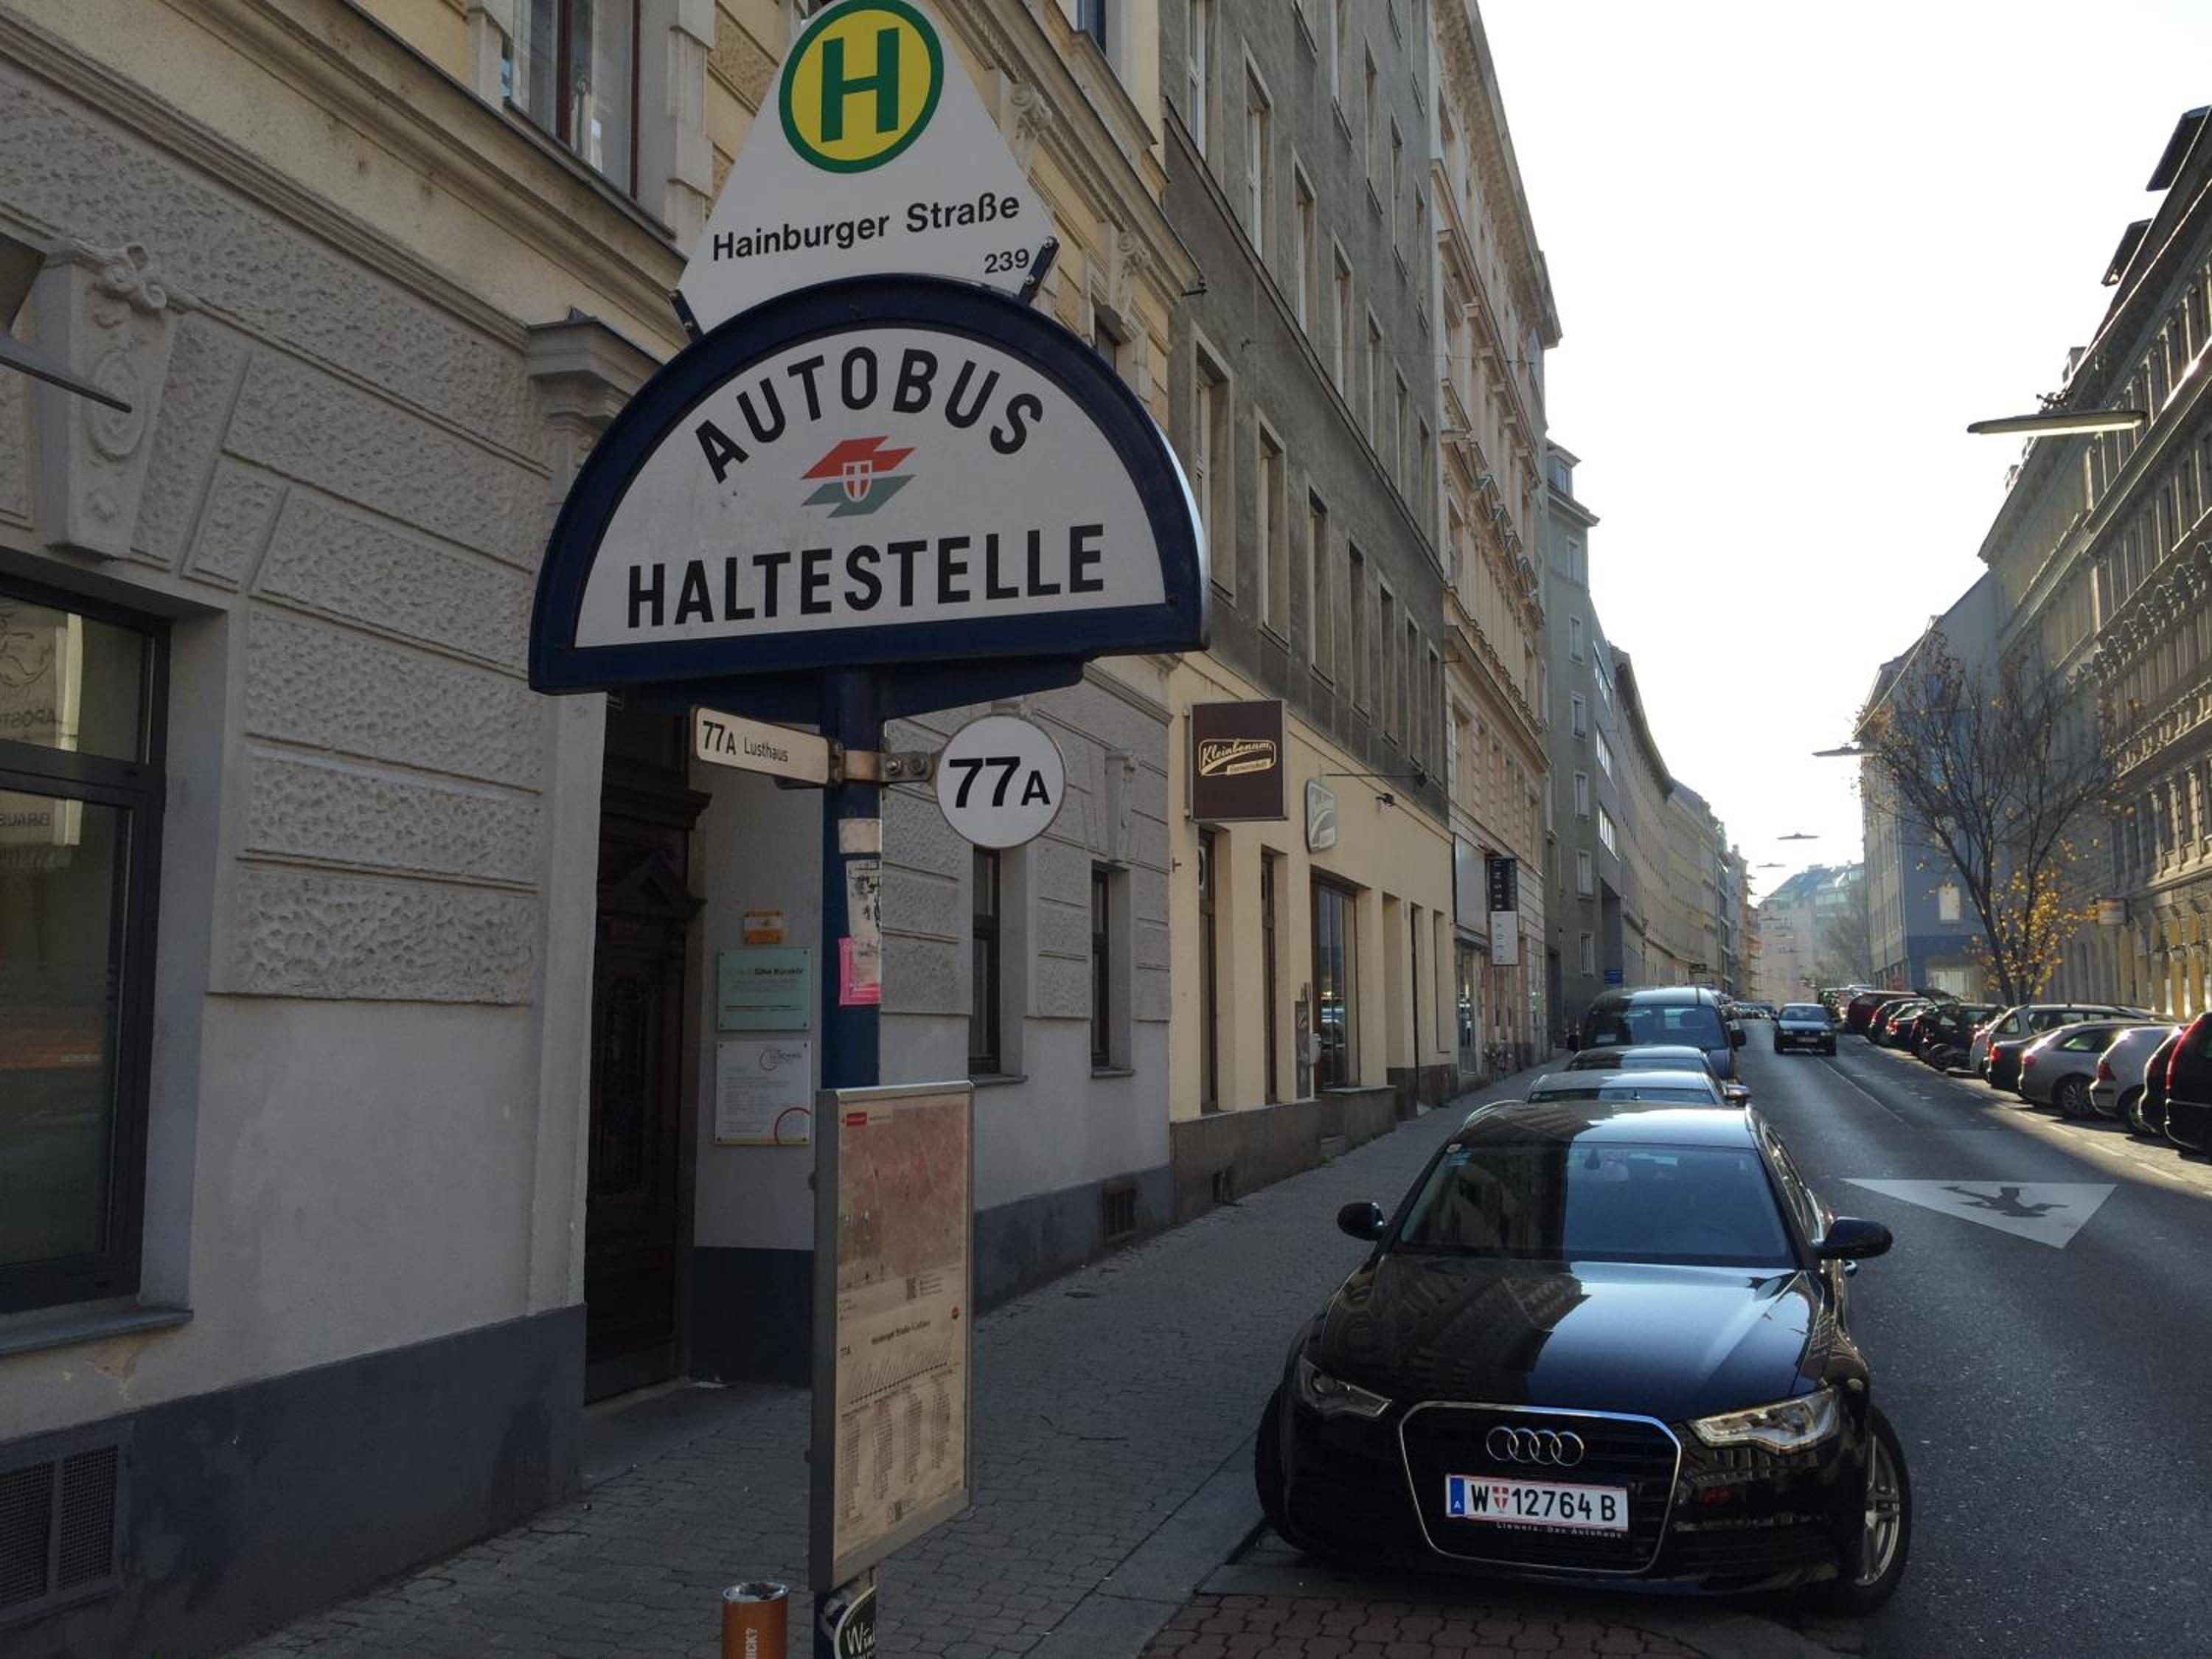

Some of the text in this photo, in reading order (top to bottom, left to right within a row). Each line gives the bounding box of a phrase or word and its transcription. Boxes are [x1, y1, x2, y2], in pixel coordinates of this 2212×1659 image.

[821, 27, 900, 143] H
[713, 192, 1020, 262] Hainburger Straße
[984, 248, 1030, 274] 239
[695, 347, 1043, 484] AUTOBUS
[627, 524, 1104, 629] HALTESTELLE
[703, 720, 789, 763] 77A Lusthaus
[949, 756, 1051, 809] 77A
[1453, 1500, 1462, 1509] A
[1471, 1484, 1617, 1522] W 12764 B
